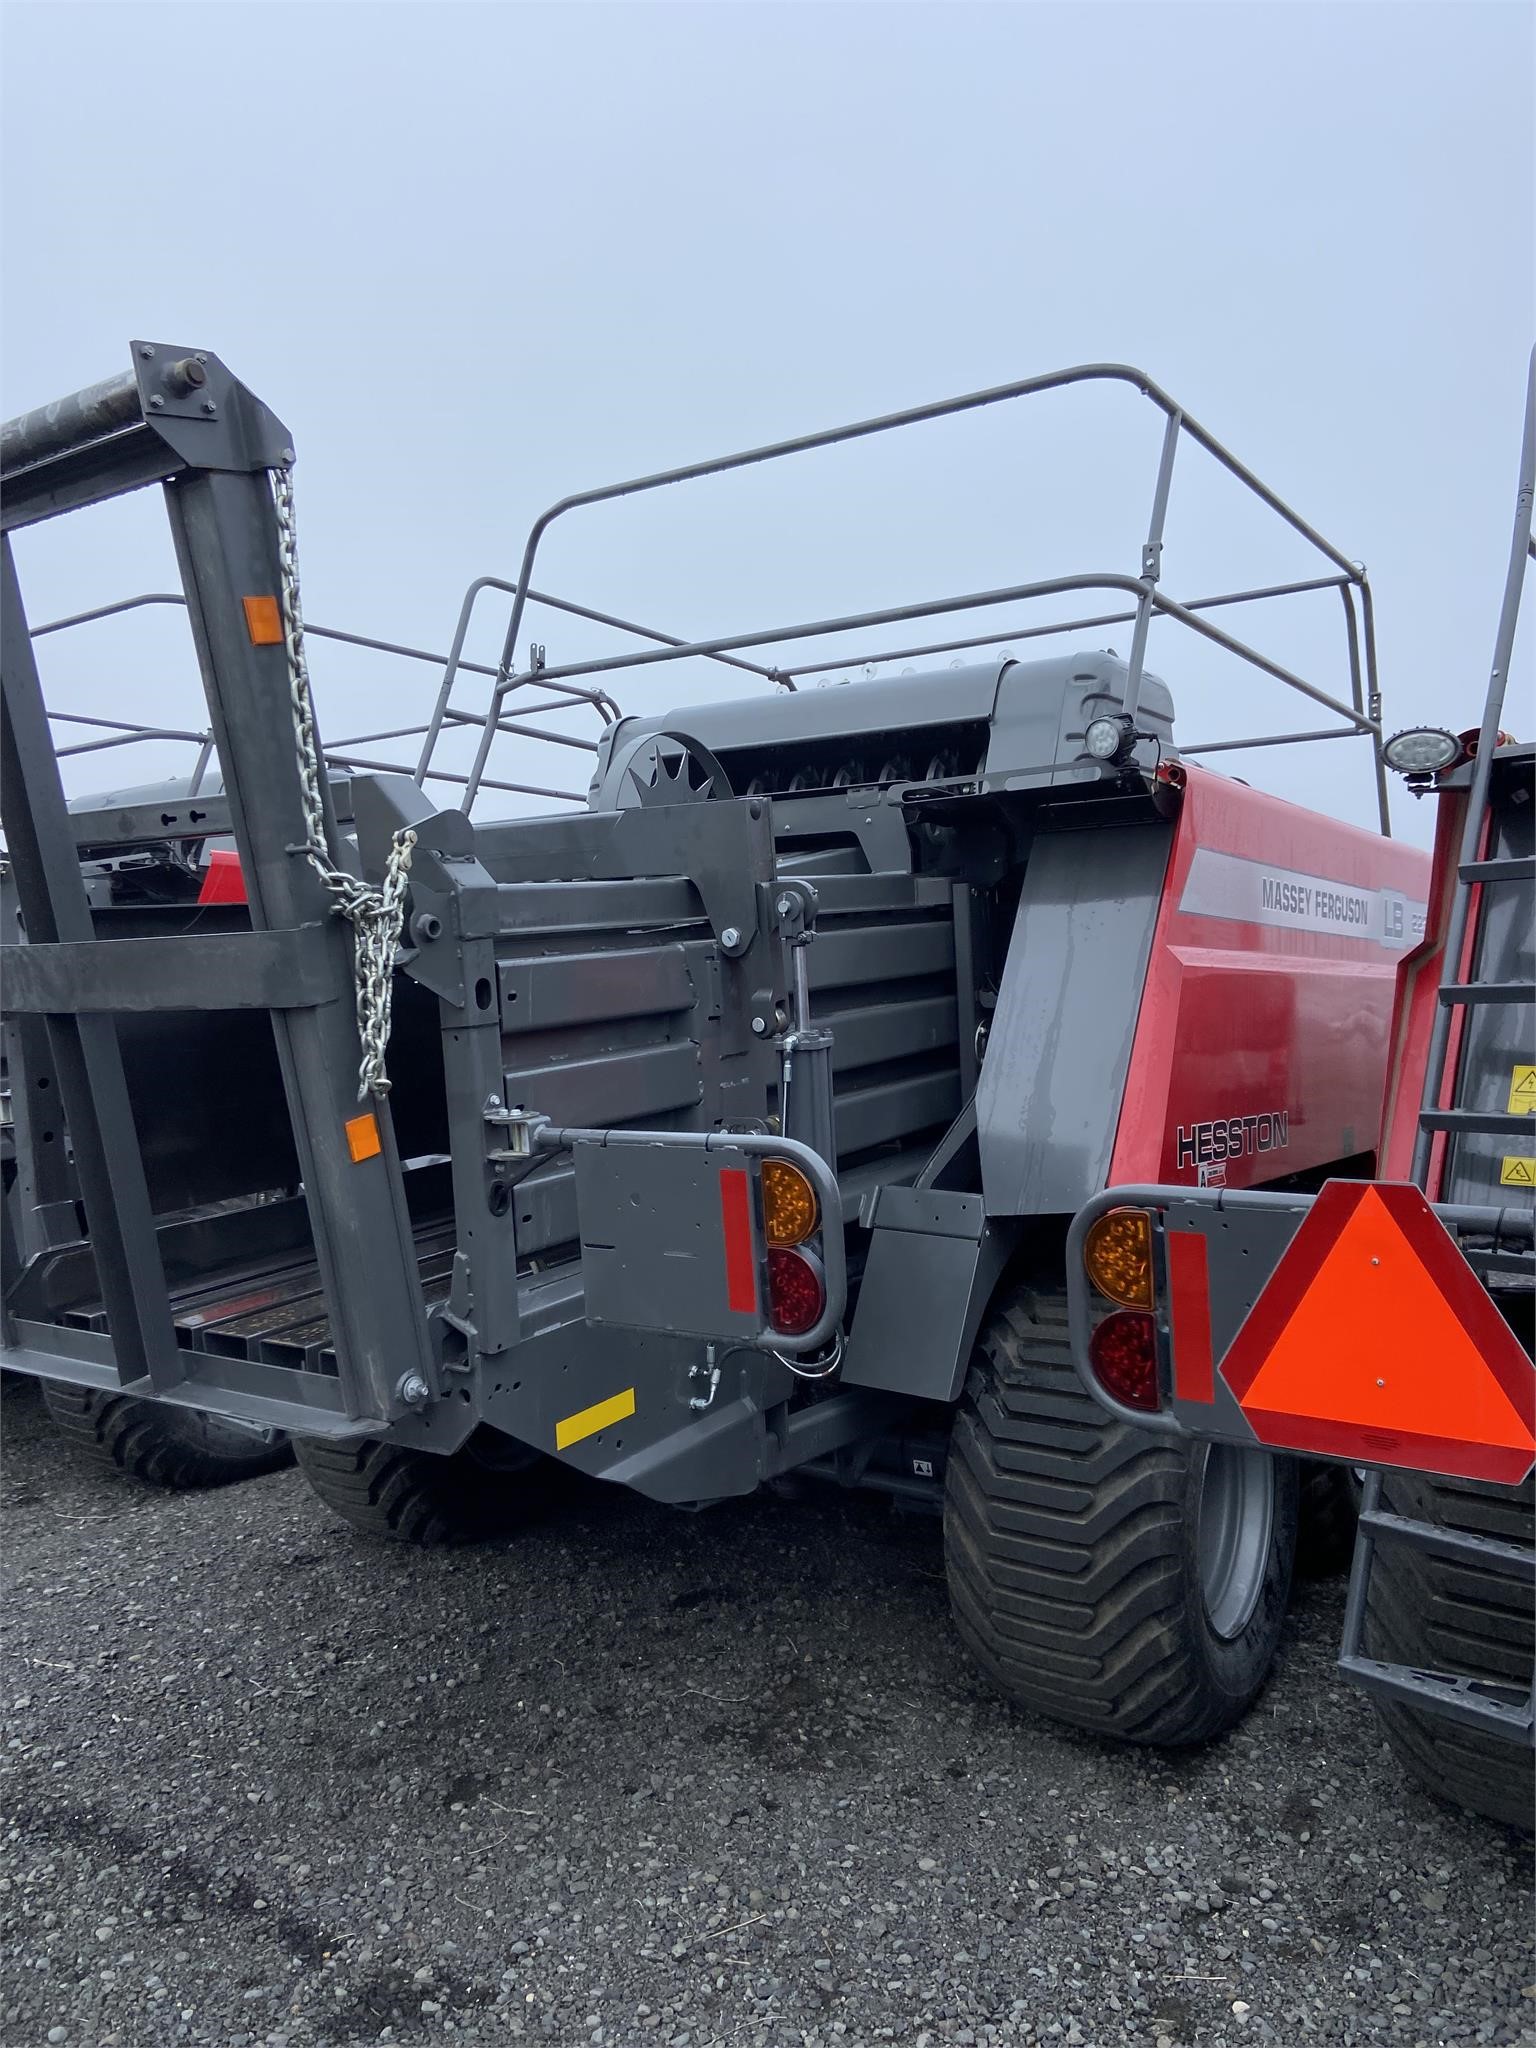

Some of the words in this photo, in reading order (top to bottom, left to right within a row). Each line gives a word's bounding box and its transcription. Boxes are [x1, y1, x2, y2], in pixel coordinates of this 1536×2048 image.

[1261, 878, 1312, 915] MASSEY
[1315, 890, 1368, 925] FERGUSON
[1383, 899, 1404, 939] LB
[1177, 1111, 1288, 1169] HESSTON
